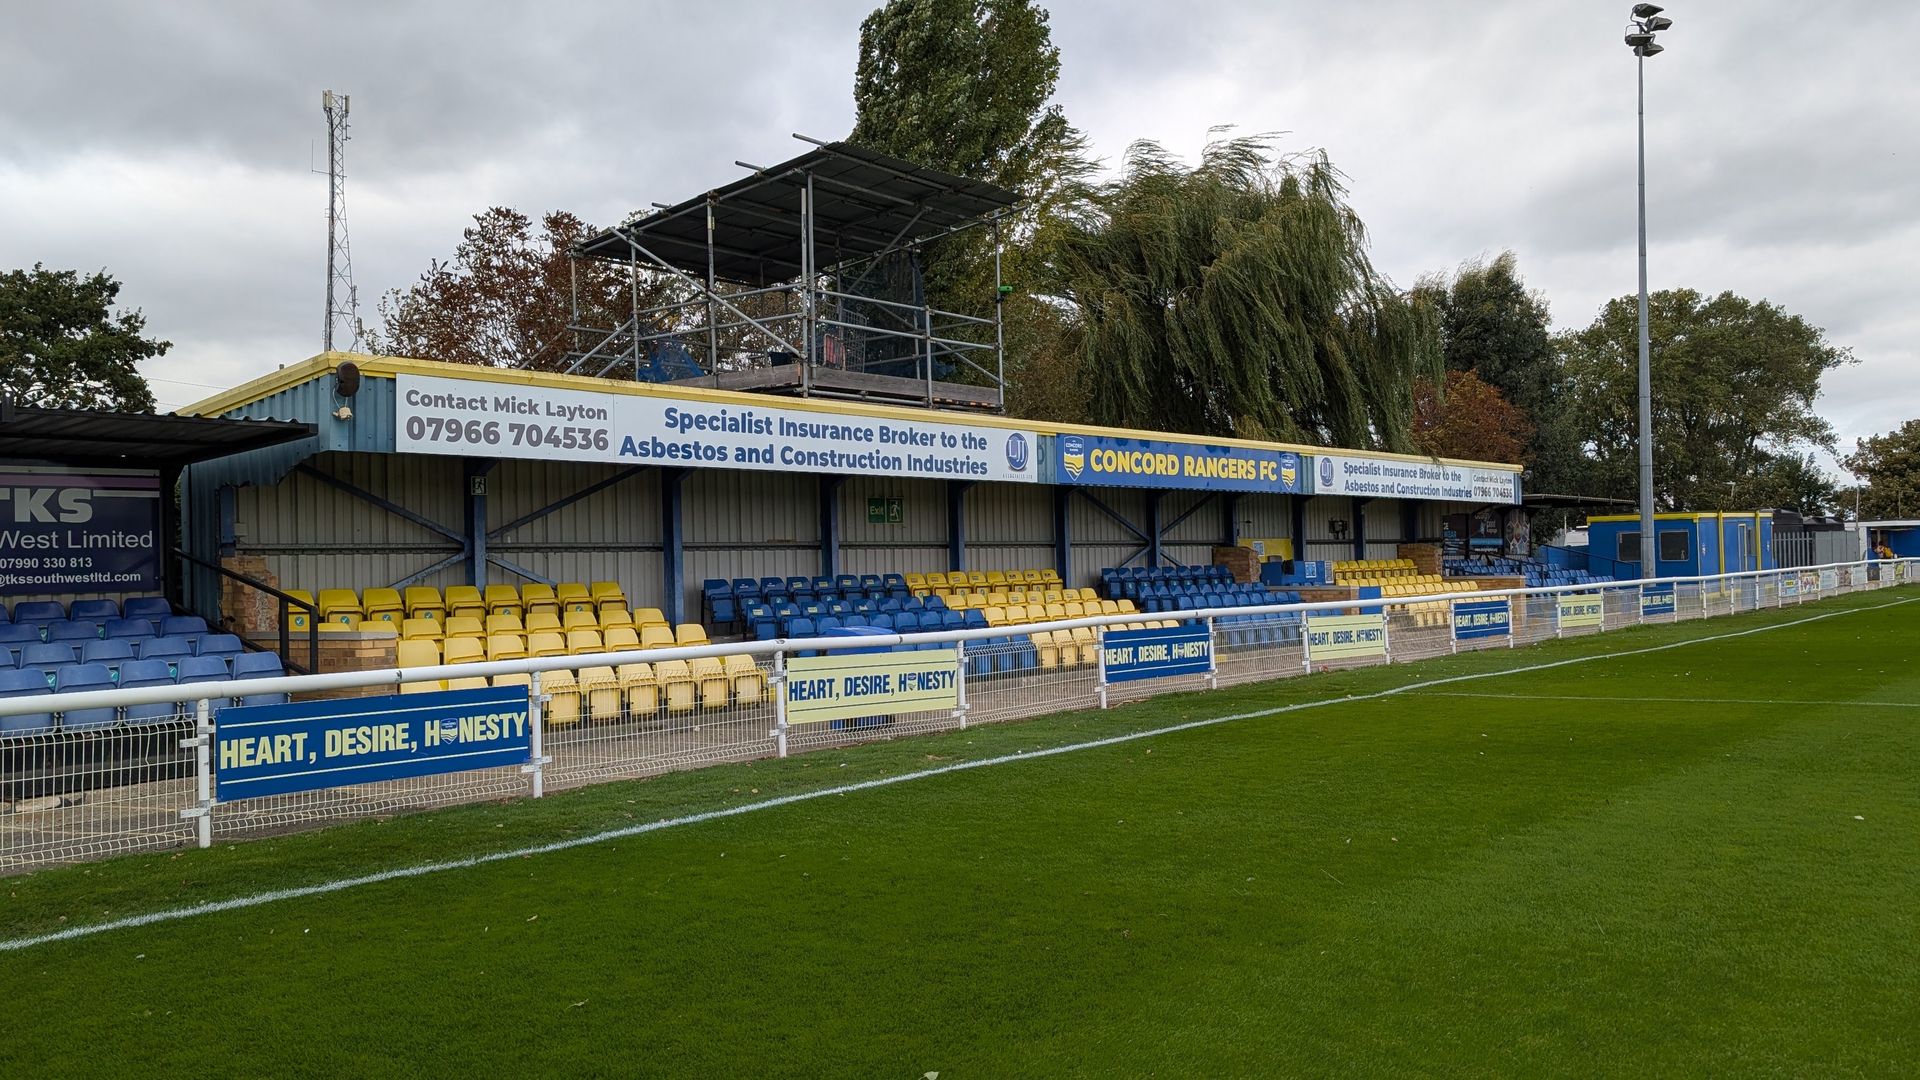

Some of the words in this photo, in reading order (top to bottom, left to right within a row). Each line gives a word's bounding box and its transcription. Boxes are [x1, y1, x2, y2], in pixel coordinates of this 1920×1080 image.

[405, 389, 488, 412] Contact
[493, 396, 540, 416] Mick
[545, 401, 608, 422] Layton
[405, 415, 501, 445] 07966
[508, 422, 609, 452] 704536
[664, 407, 773, 436] Specialist
[779, 416, 874, 443] Insurance
[878, 425, 936, 448] Broker
[940, 431, 958, 449] to
[961, 432, 988, 451] the
[619, 435, 728, 462] Asbestos
[734, 444, 774, 464] and
[780, 445, 901, 472] Construction
[907, 453, 988, 475] Industries
[1090, 448, 1180, 476] CONCORD
[1184, 455, 1256, 481] RANGERS
[1259, 460, 1278, 482] FC
[1343, 461, 1382, 477] Specialist
[1382, 464, 1418, 479] Insurance
[1419, 468, 1442, 481] Broker
[1442, 469, 1450, 482] to
[1450, 471, 1462, 482] the
[1473, 474, 1489, 483] Contact
[1344, 479, 1380, 493] Asbestos
[1380, 481, 1395, 494] and
[1396, 482, 1440, 496] Construction
[1441, 485, 1473, 499] Industries
[1473, 485, 1492, 498] 07966
[0, 487, 93, 524] KS
[869, 505, 885, 515] Exit
[0, 530, 60, 549] West
[67, 529, 154, 549] Limited
[0, 557, 40, 570] 07990
[43, 557, 67, 569] 330
[69, 556, 93, 568] 813
[1309, 631, 1333, 647] HEART,
[1333, 630, 1356, 645] DESIRE,
[1356, 628, 1383, 642] HNESTY
[1104, 647, 1137, 666] HEART,
[1138, 643, 1171, 663] DESIRE,
[1172, 640, 1209, 660] HNESTY
[788, 678, 840, 702] HEART,
[844, 673, 895, 697] DESIRE,
[898, 669, 957, 692] HNESTY
[219, 732, 317, 770] HEART,
[324, 721, 418, 758] DESIRE,
[424, 711, 528, 748] HNESTY
